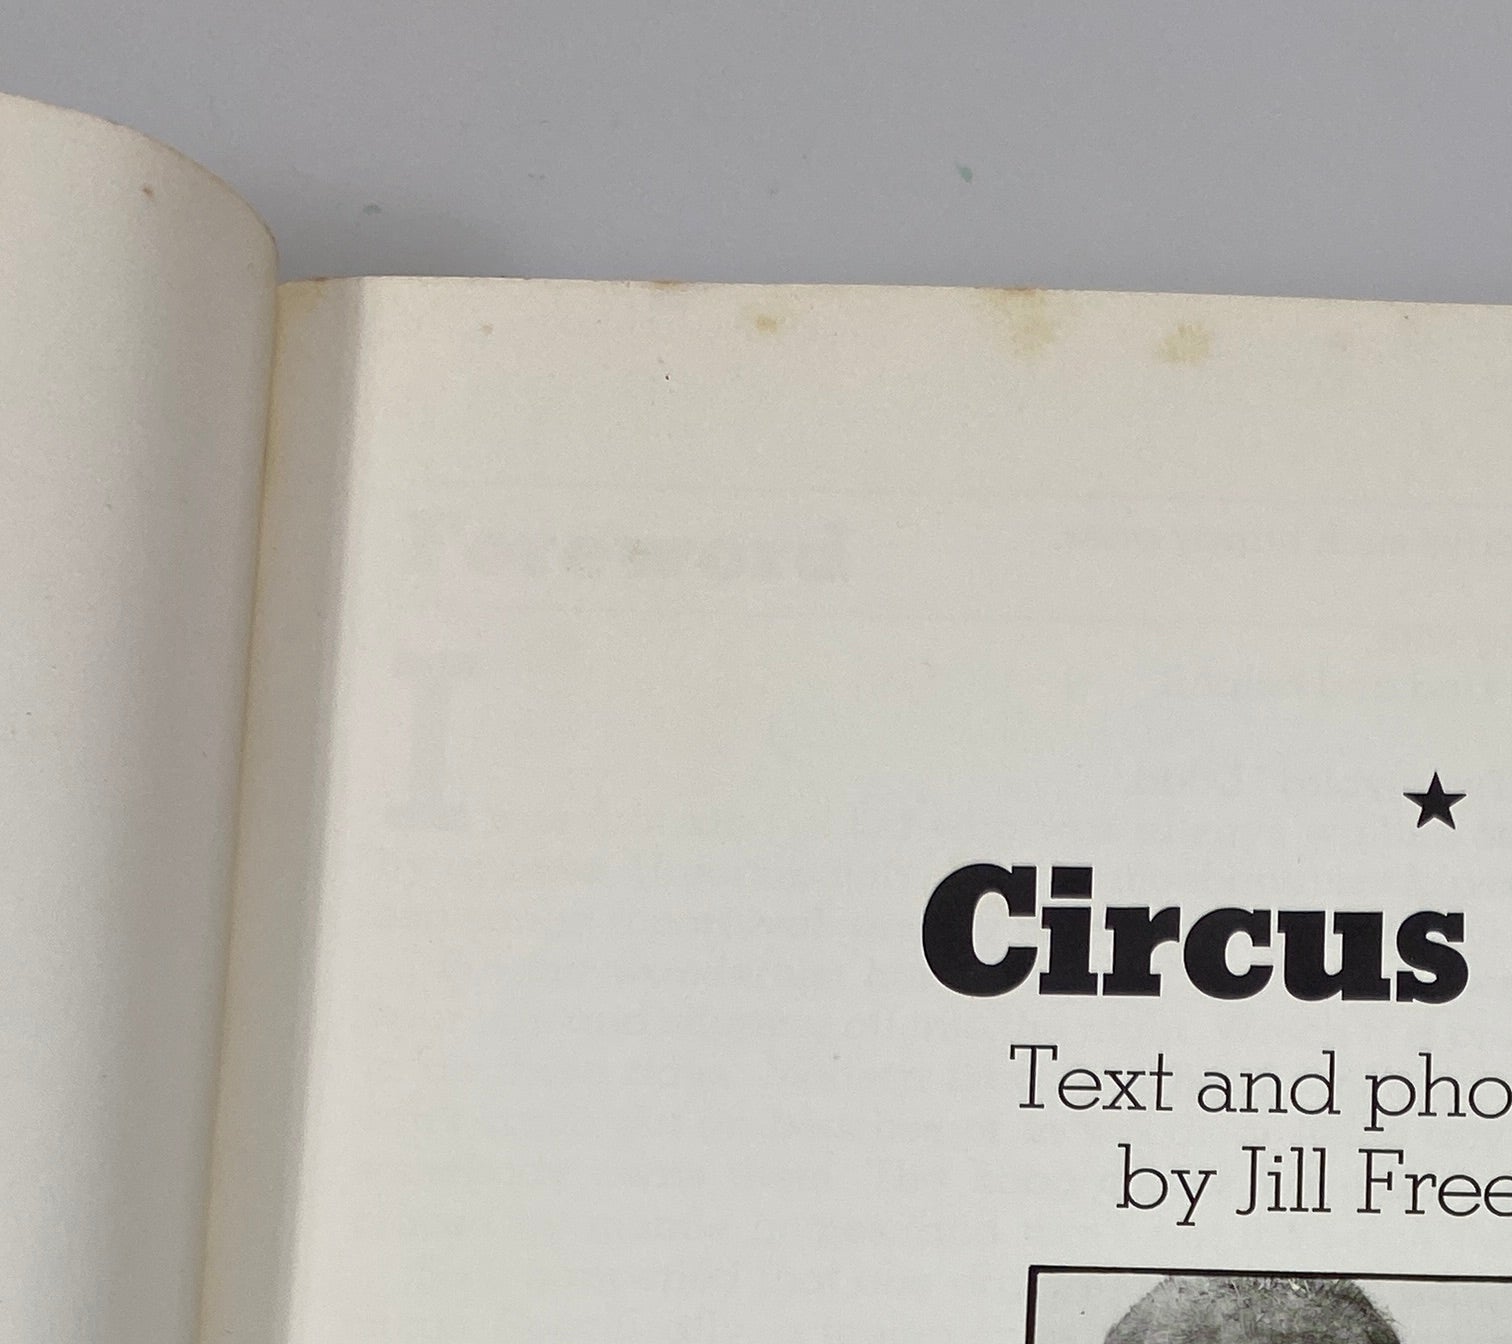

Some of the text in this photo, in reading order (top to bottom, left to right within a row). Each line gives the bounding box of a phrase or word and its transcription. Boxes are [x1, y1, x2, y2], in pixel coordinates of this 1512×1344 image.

[922, 863, 1469, 1004] Circus
[1010, 1044, 1173, 1112] Text
[1198, 1050, 1341, 1116] and
[1116, 1143, 1218, 1227] by
[1236, 1146, 1332, 1217] Jill
